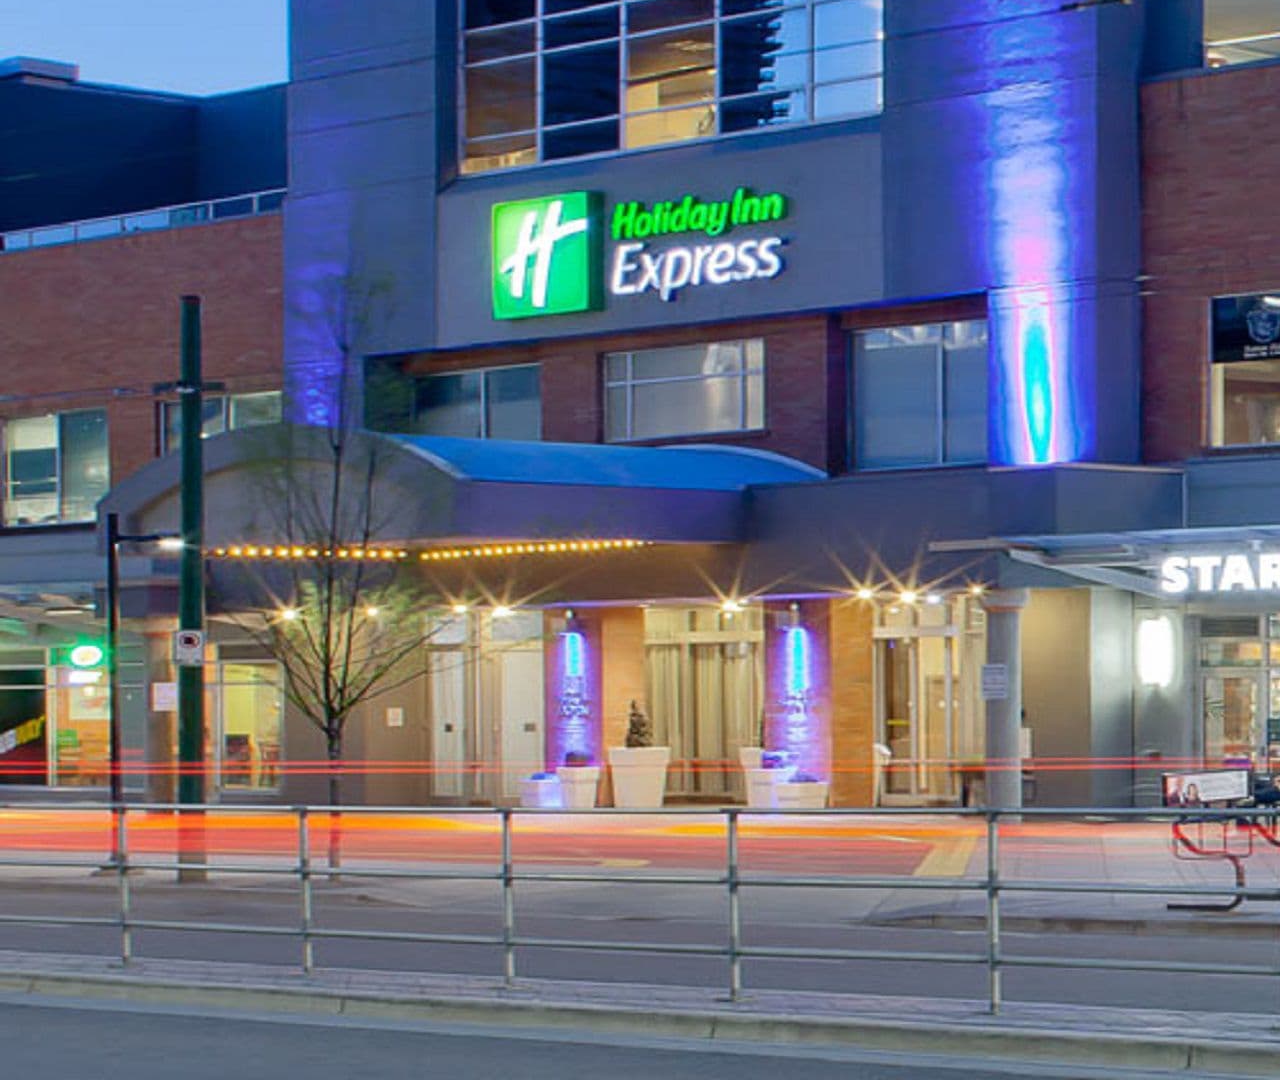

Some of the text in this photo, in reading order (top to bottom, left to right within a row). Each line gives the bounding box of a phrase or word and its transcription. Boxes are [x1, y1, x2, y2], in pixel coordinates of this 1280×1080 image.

[611, 186, 784, 237] Holiday Inn
[611, 236, 783, 302] Express
